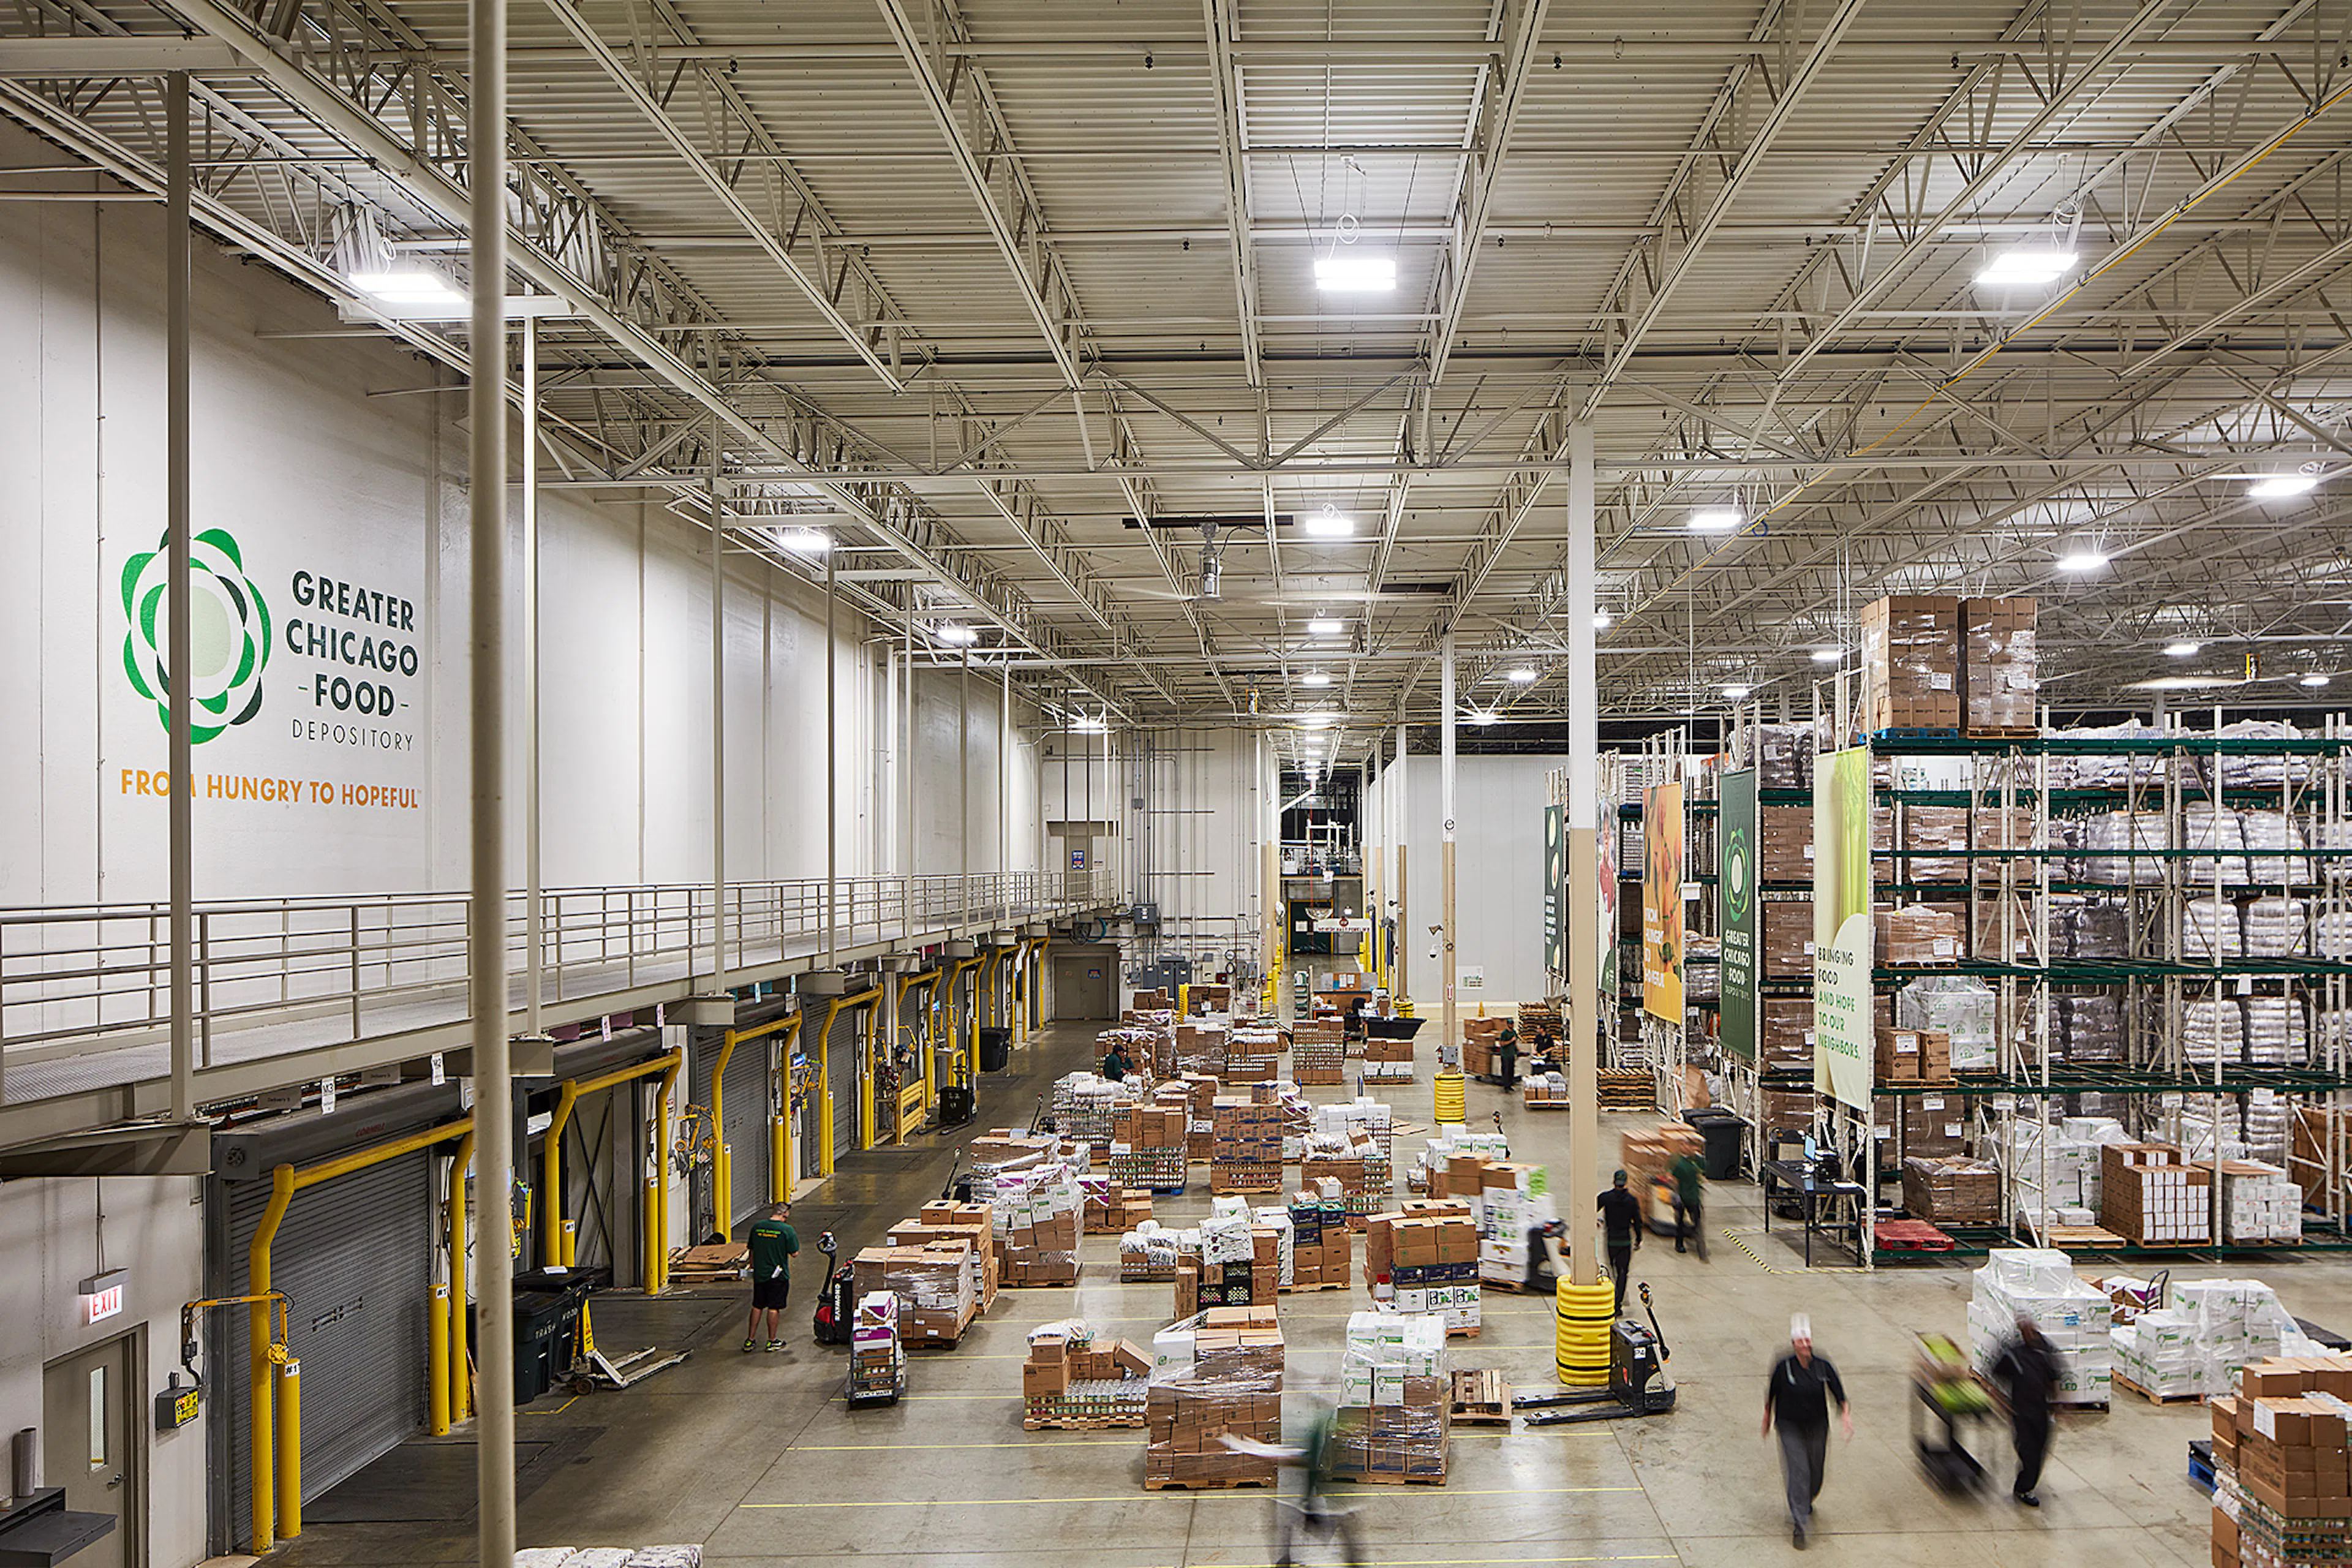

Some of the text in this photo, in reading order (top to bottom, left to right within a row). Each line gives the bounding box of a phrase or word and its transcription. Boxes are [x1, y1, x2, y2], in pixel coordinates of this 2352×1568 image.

[292, 571, 413, 632] GREATER
[287, 619, 418, 676] CHICAGO
[292, 719, 413, 751] DEPOSITORY
[122, 769, 196, 797] FRO
[207, 774, 302, 803] HUNGRY
[309, 782, 334, 804] TO
[1818, 947, 1853, 966] BRINGING
[1818, 969, 1838, 985] FOOD
[1819, 990, 1855, 1012] AND HOPE
[1819, 1012, 1844, 1031] TO OUR
[1818, 1033, 1860, 1060] NEIGHBORS.
[92, 1288, 118, 1316] EXIT
[286, 1365, 296, 1374] #1
[2060, 1382, 2077, 1391] LED
